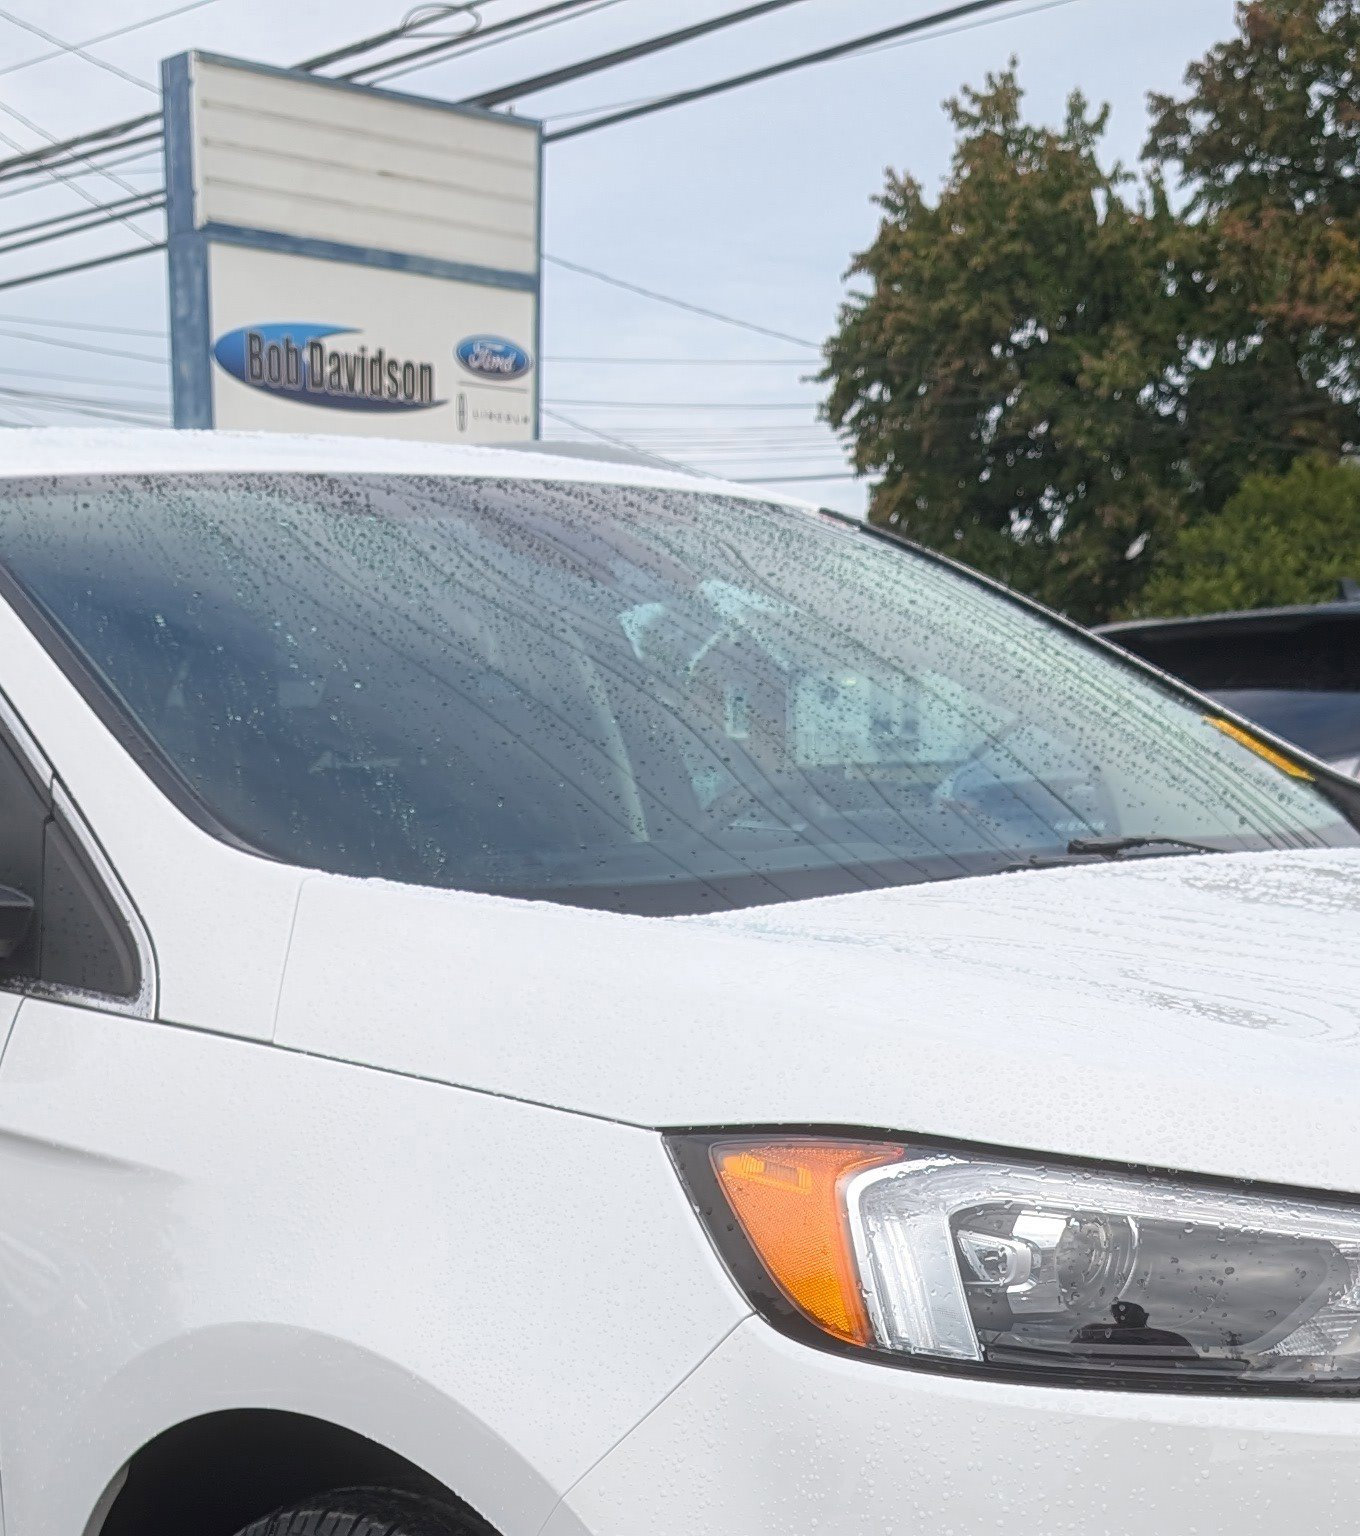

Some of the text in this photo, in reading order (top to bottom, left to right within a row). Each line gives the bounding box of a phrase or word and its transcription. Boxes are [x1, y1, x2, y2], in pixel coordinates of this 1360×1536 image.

[245, 332, 433, 402] Bob Davidson
[468, 342, 517, 373] Ford
